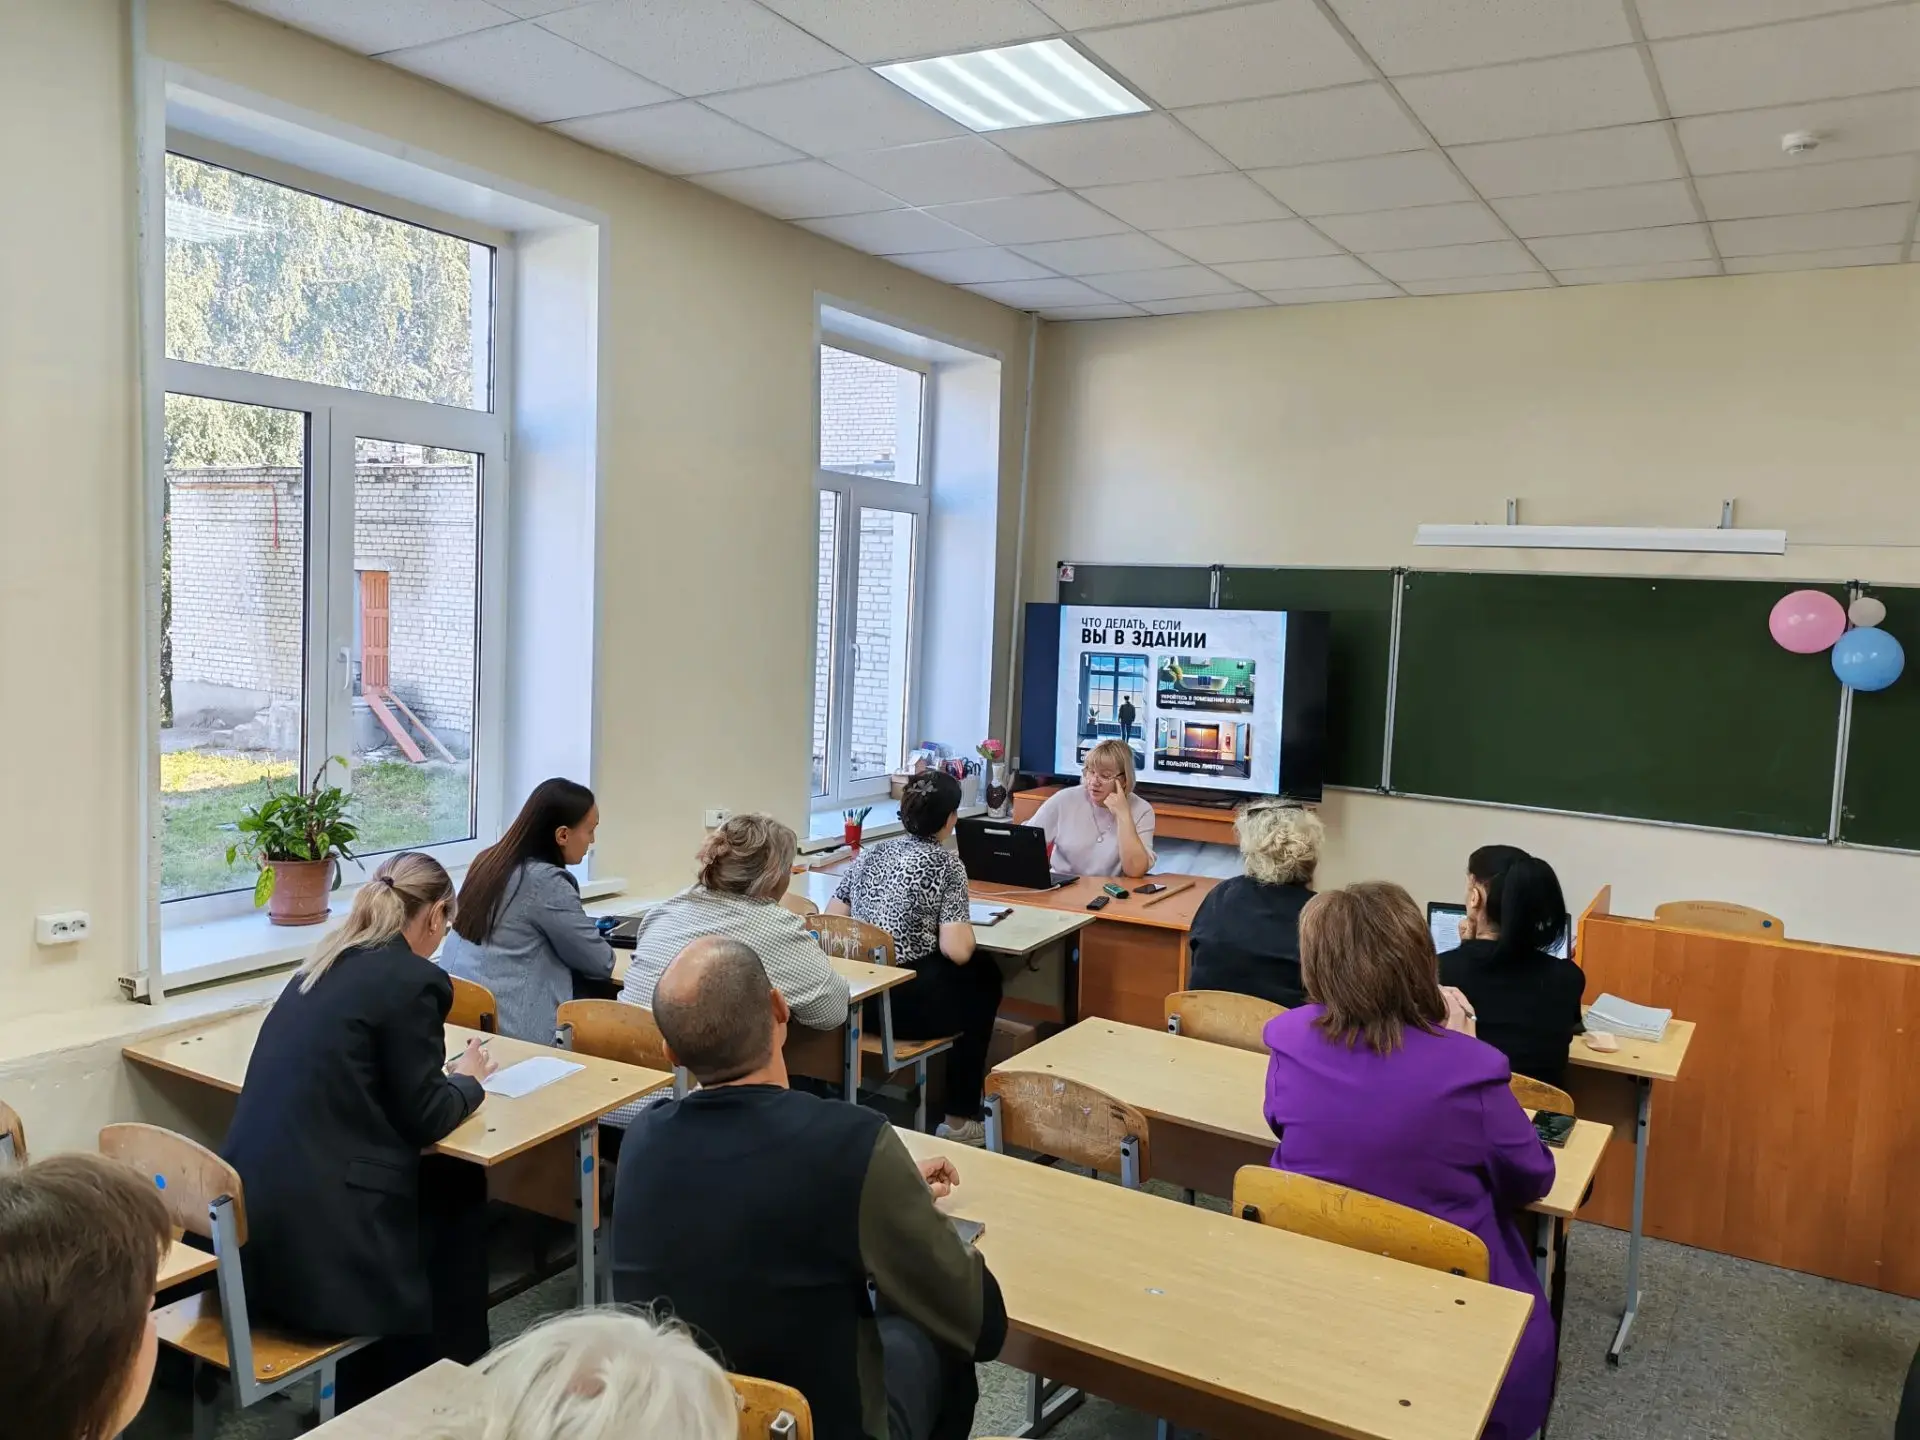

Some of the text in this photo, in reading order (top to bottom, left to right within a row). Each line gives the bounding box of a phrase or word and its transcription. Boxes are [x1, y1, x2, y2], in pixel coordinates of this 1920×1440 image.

[1081, 617, 1182, 631] ЧТО ДЕЛАТЬ, ЕСЛИ
[1081, 628, 1207, 649] ВЫ В ЗДАНИИ
